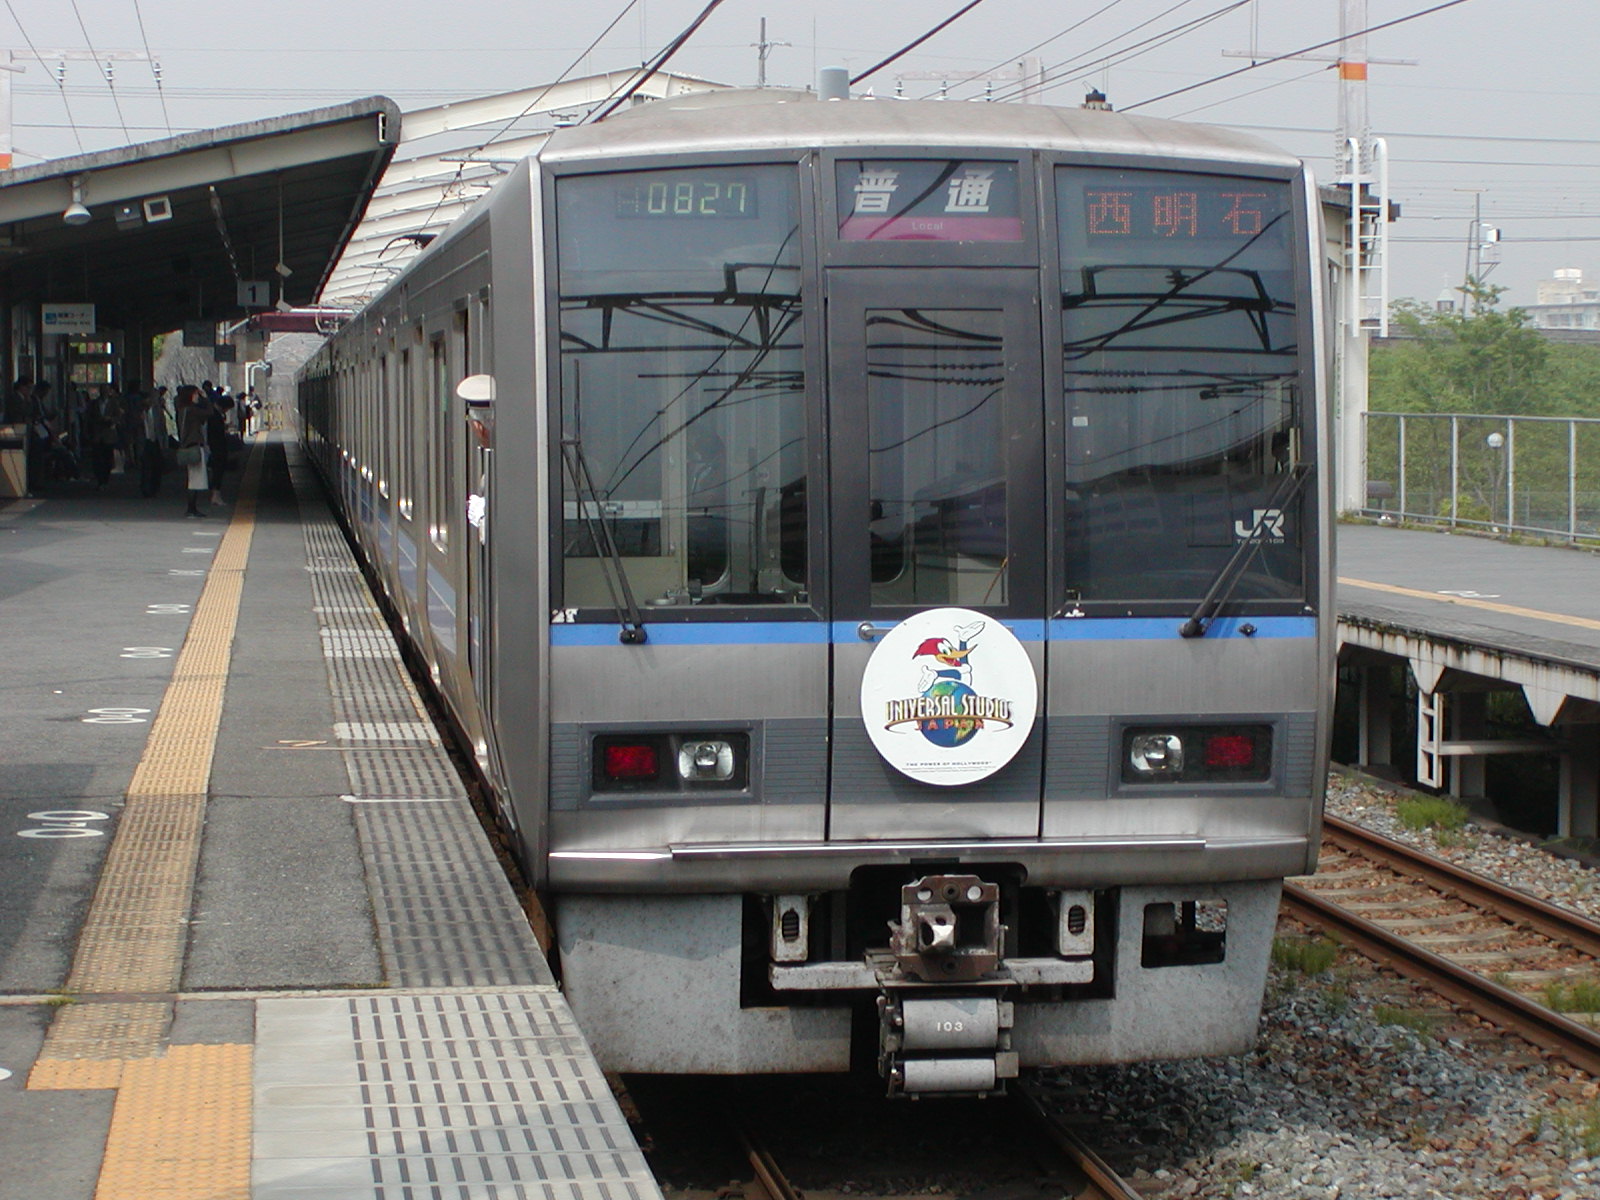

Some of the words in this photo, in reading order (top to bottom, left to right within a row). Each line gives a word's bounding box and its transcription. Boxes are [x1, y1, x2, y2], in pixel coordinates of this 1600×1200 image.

[854, 169, 996, 212] 普通
[1088, 192, 1266, 236] 西明石
[911, 221, 944, 231] Local
[248, 284, 257, 303] 1
[1235, 509, 1285, 537] JR
[886, 694, 957, 721] UNIVERSAL
[914, 719, 985, 731] JAPAN
[937, 1022, 963, 1031] 103
